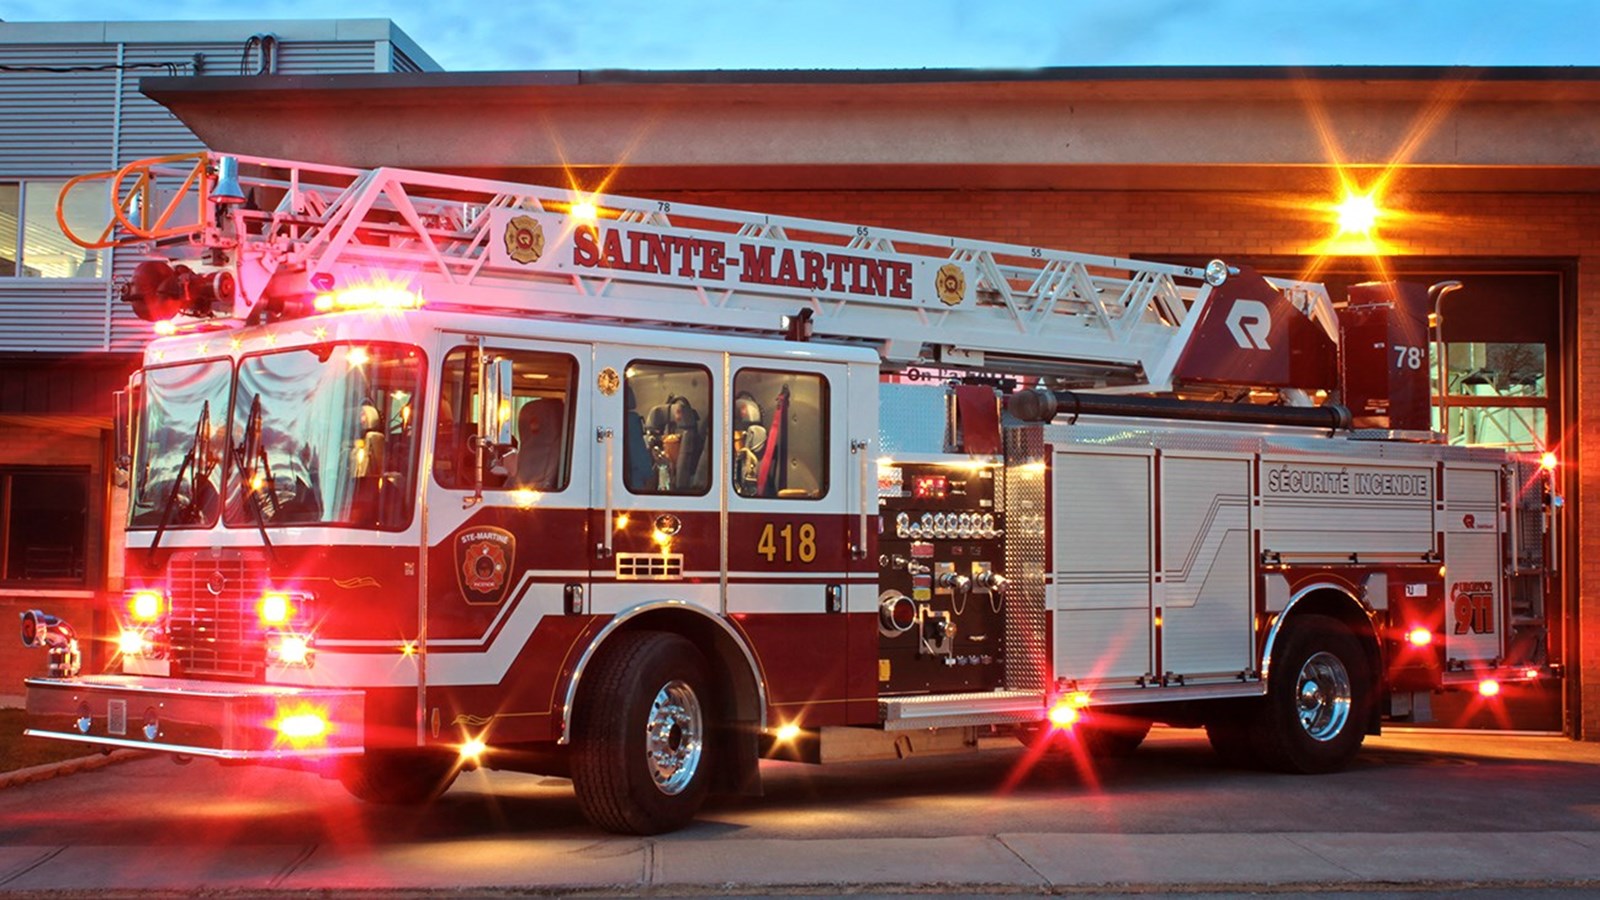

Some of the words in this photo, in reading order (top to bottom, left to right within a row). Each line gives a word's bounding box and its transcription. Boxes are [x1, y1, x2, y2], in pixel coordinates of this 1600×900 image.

[657, 201, 671, 213] 78
[856, 226, 869, 237] 65
[573, 224, 913, 300] SAINTE-MARTINE
[1031, 247, 1042, 258] 55
[1268, 464, 1350, 494] SÉCURITÉ
[1354, 473, 1428, 496] INCENDIE
[460, 532, 509, 545] STE-MARTINE
[757, 522, 817, 563] 418
[1454, 592, 1495, 636] 911
